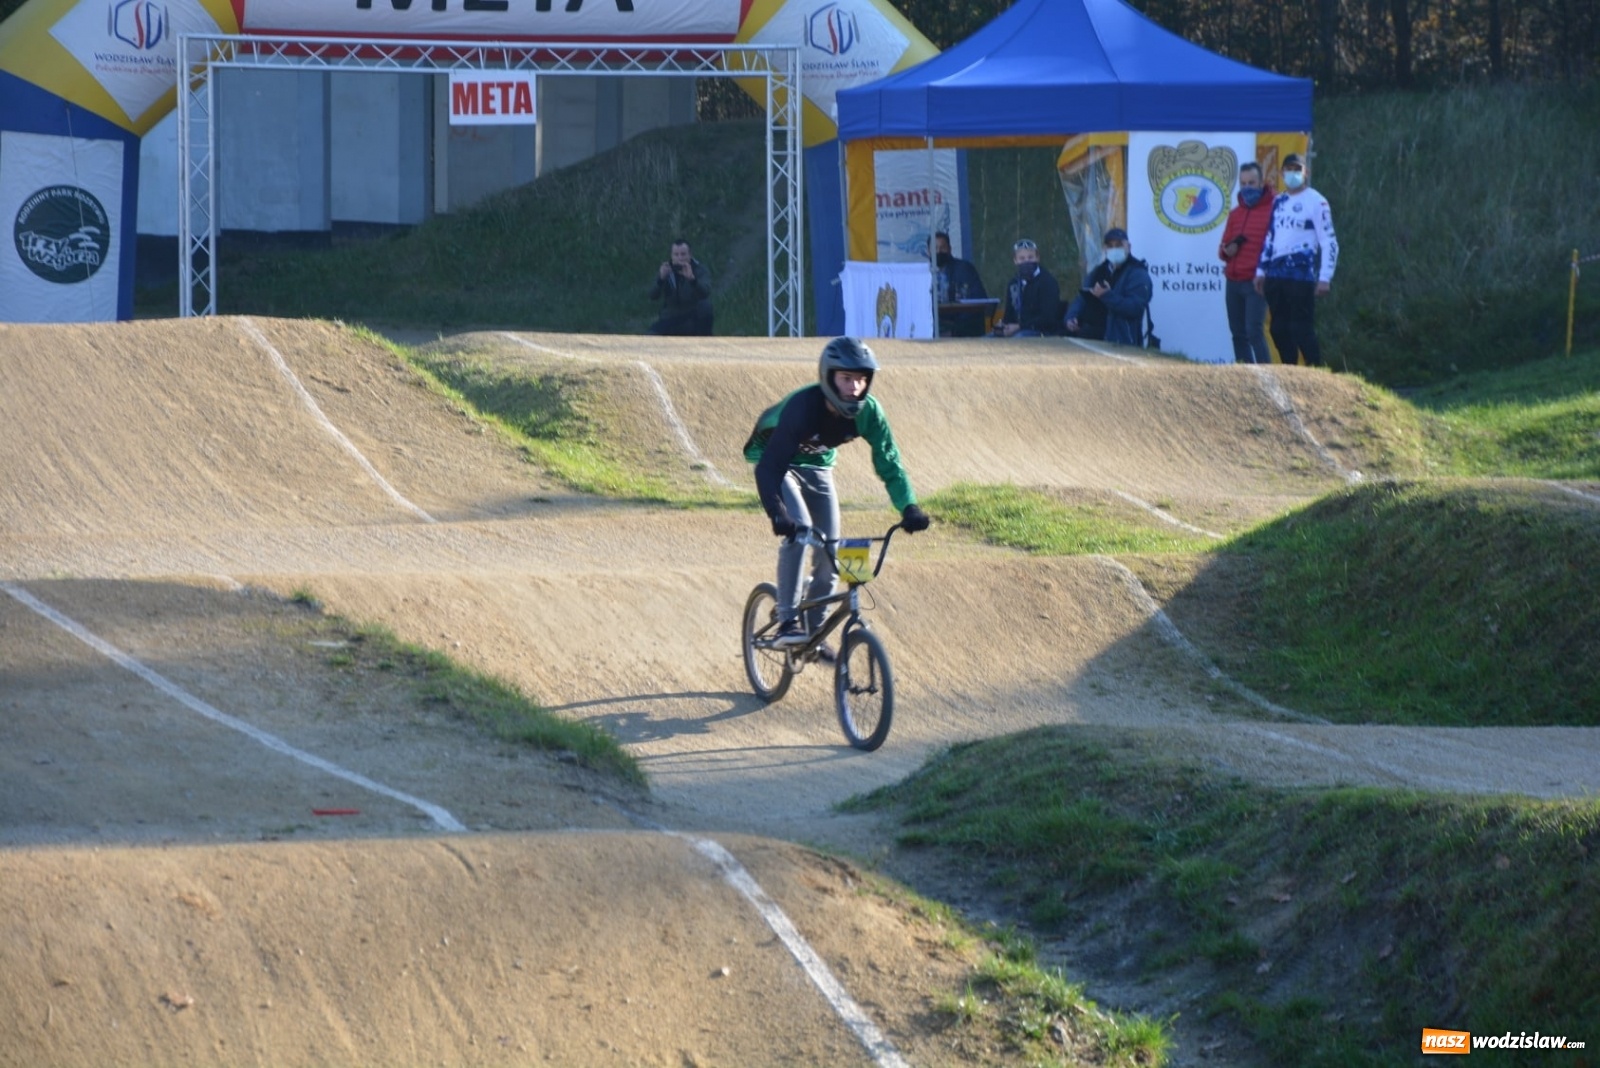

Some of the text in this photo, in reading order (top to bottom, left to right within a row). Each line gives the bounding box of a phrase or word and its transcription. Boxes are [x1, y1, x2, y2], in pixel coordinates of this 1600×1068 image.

[452, 81, 533, 115] META
[1150, 262, 1180, 277] ąski
[1162, 279, 1222, 292] Kolarski
